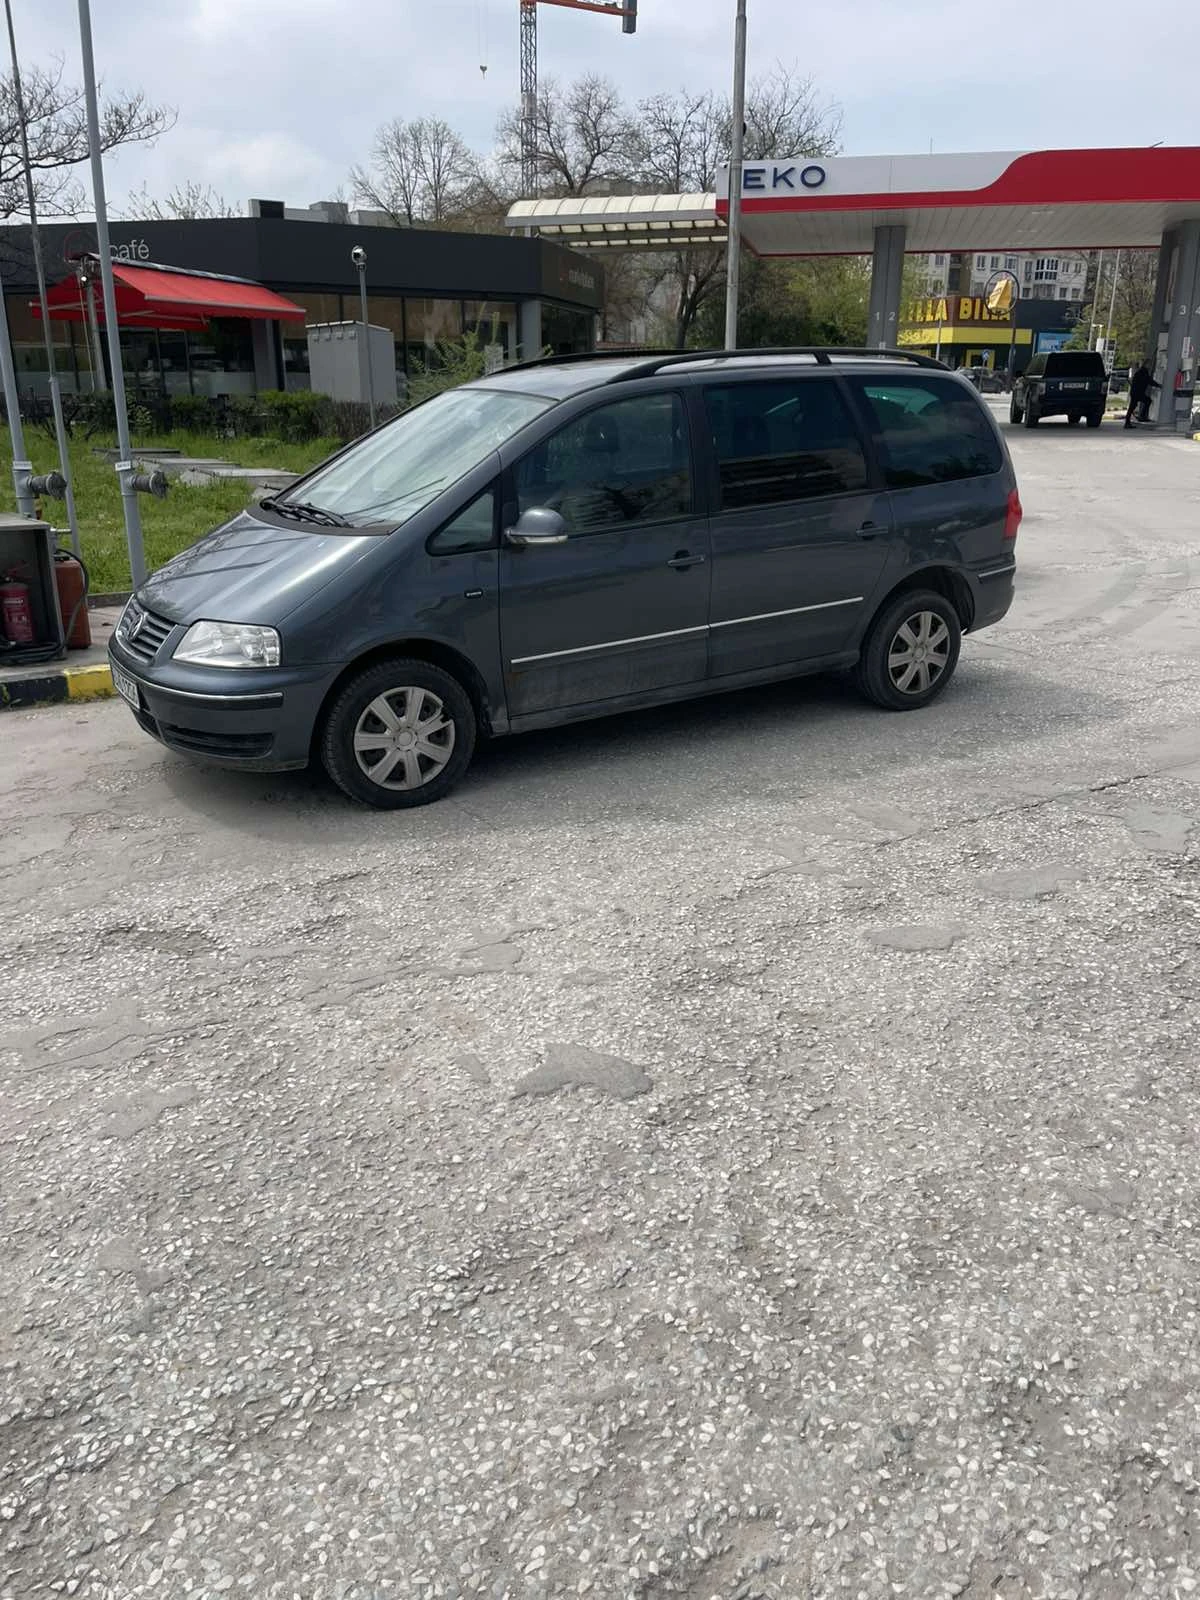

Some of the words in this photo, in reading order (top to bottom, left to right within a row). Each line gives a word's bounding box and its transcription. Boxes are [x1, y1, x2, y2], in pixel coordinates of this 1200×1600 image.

[743, 165, 826, 190] EKO
[888, 311, 896, 321] 2
[959, 297, 1011, 321] BIL
[1179, 304, 1187, 315] 3
